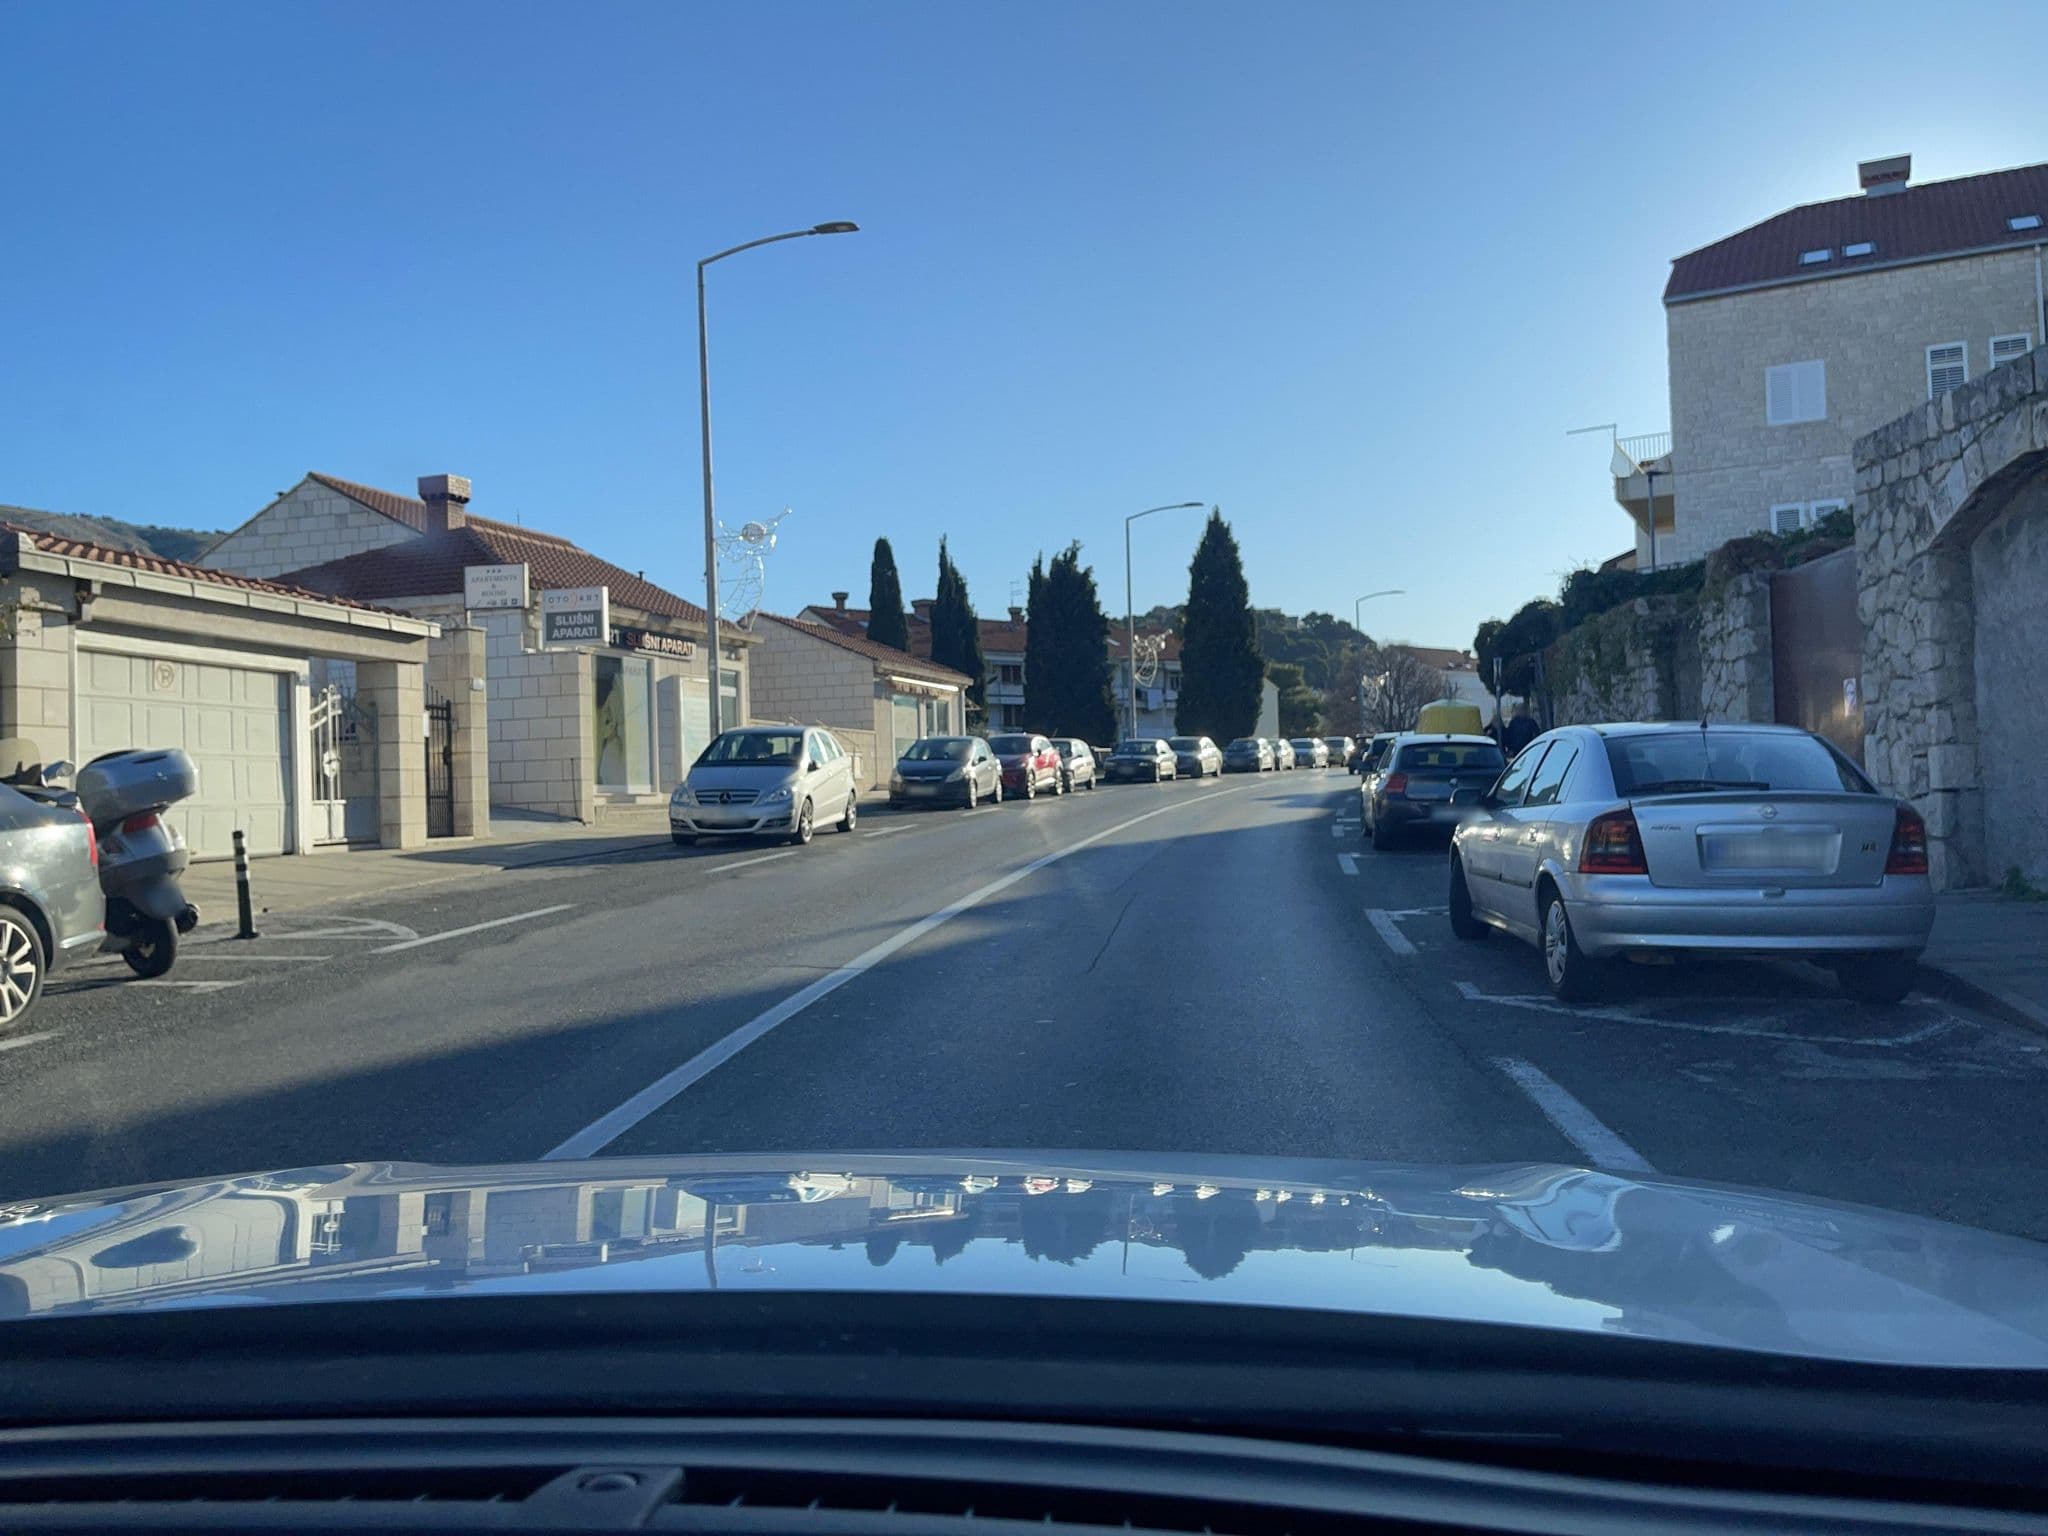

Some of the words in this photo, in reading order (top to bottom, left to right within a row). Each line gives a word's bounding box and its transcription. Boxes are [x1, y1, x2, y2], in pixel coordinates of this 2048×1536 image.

[472, 574, 518, 583] APARTMENTS
[554, 612, 595, 626] SLUŠNI
[552, 626, 599, 639] APARATI
